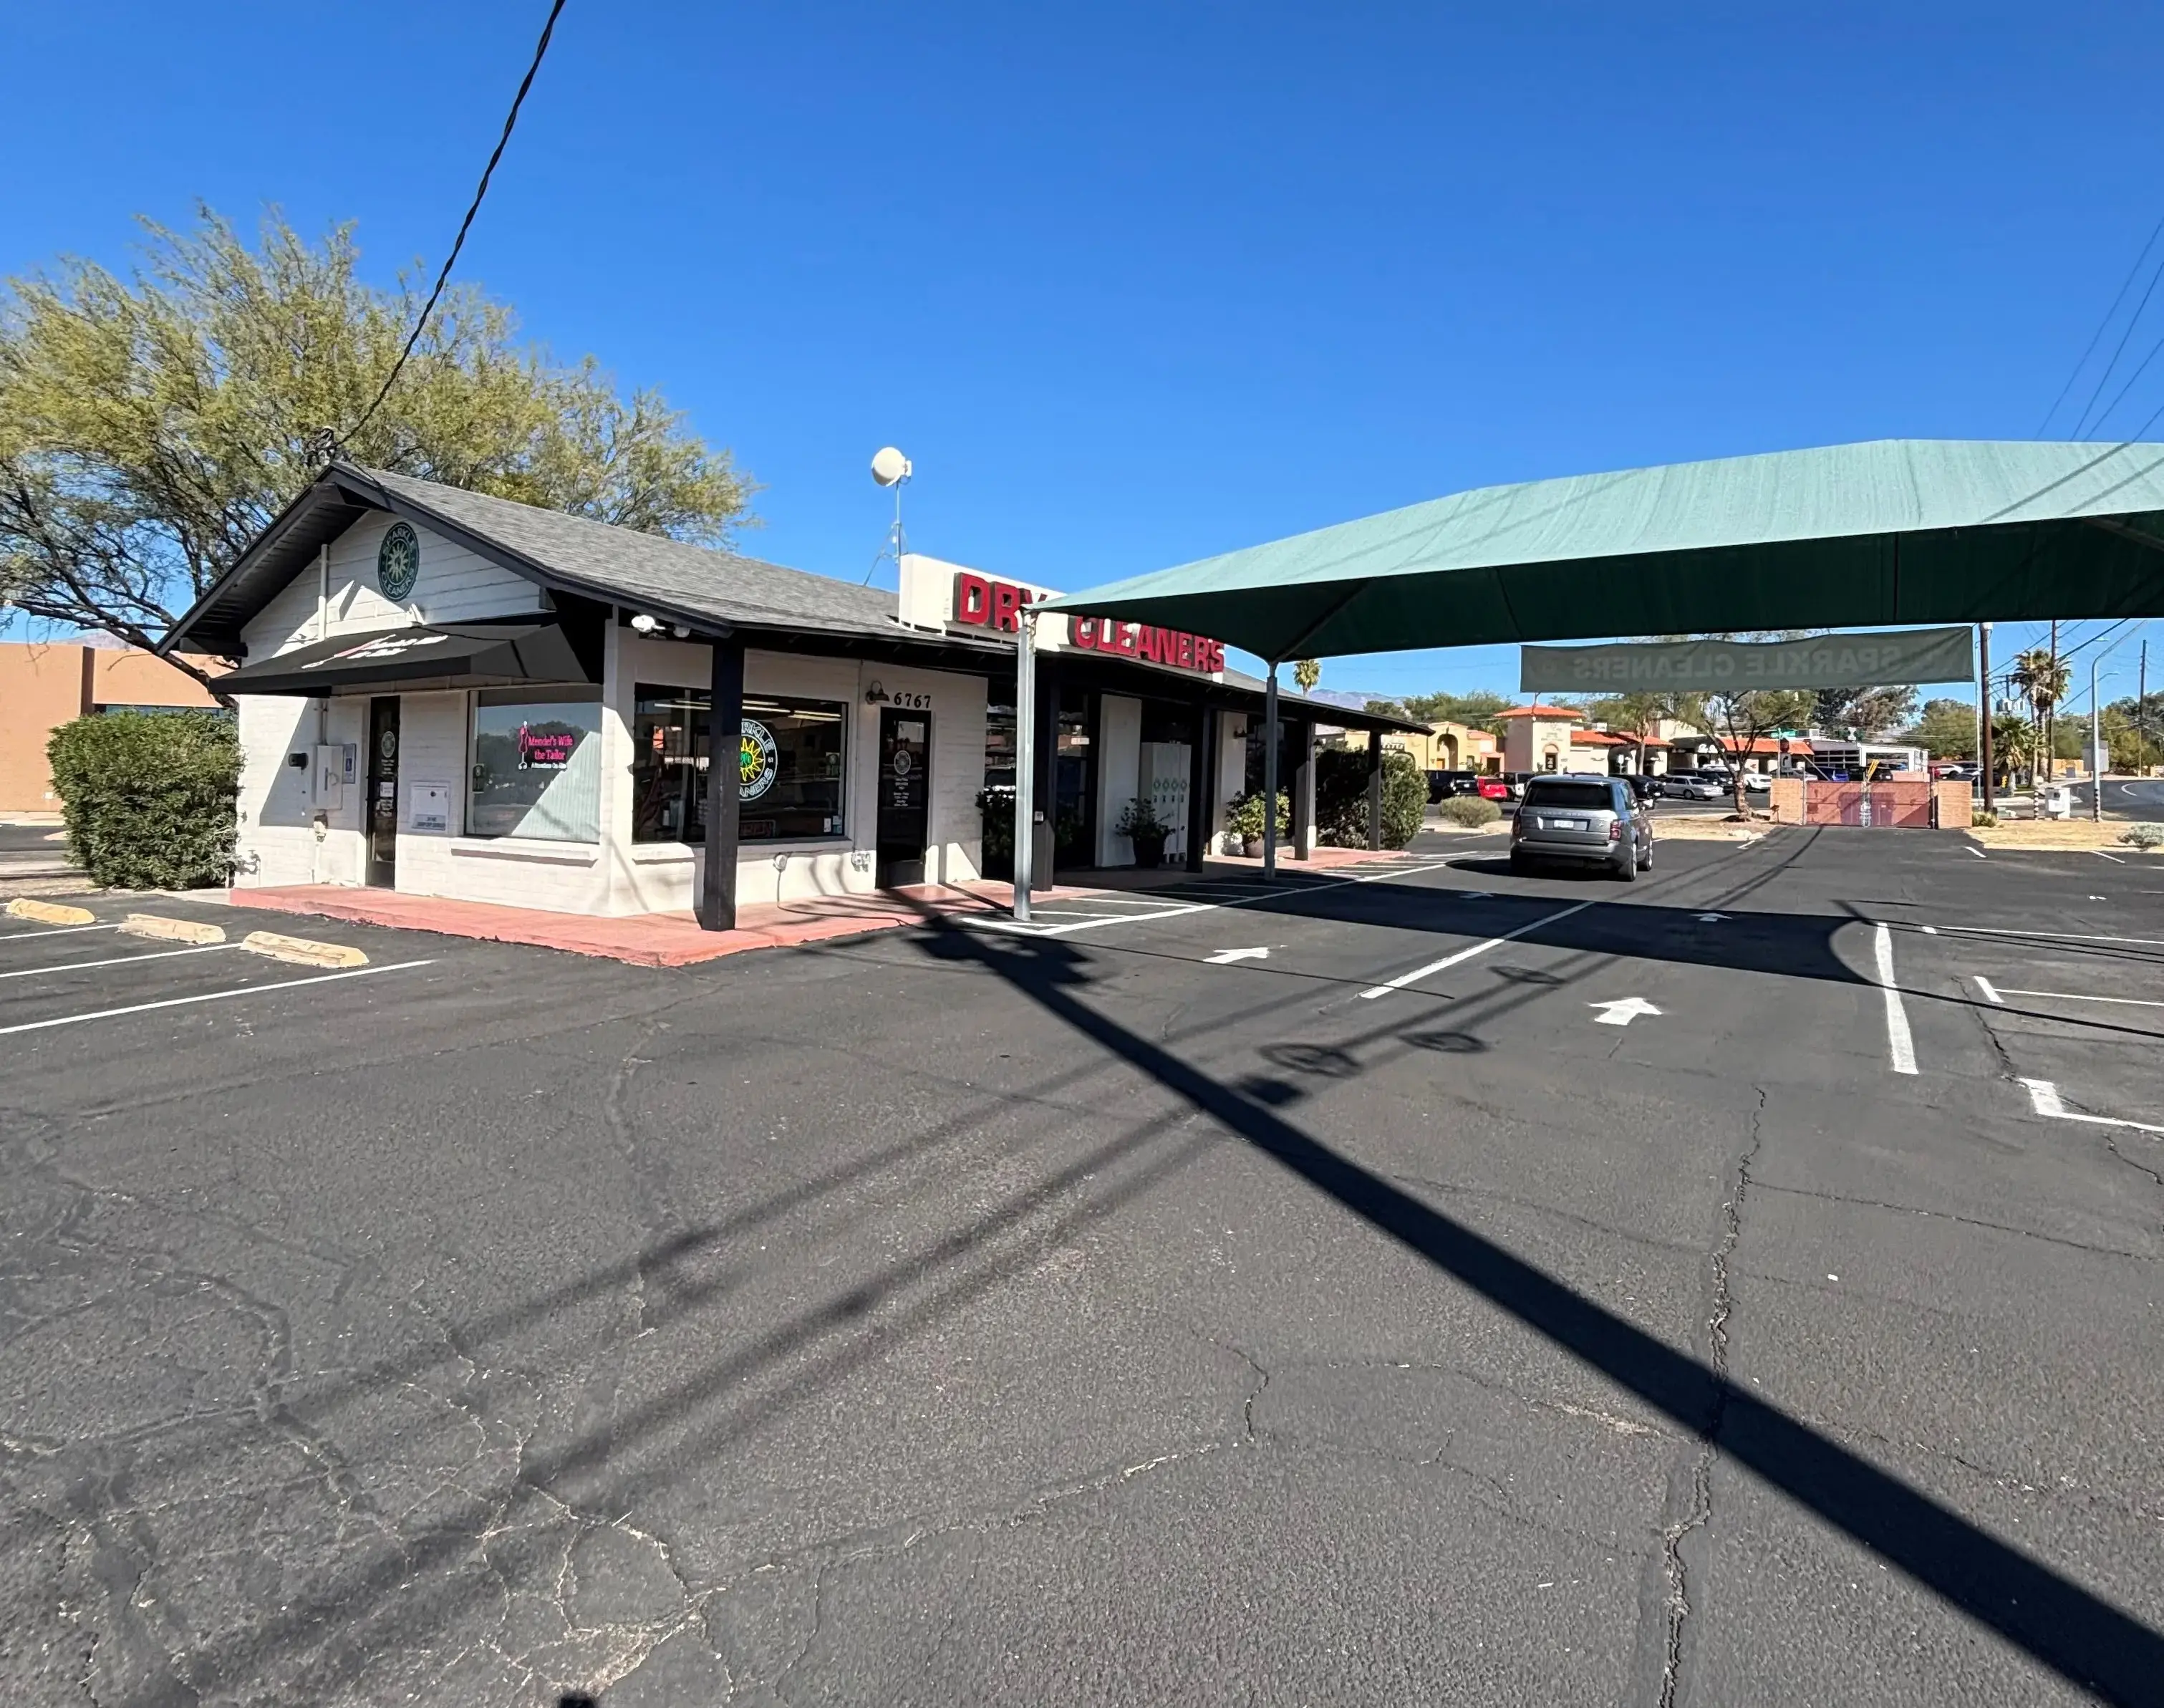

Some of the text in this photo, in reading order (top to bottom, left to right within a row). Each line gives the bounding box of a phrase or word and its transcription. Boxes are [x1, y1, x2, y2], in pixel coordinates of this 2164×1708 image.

[1071, 616, 1225, 674] CLEANERS
[894, 692, 931, 709] 6767
[558, 735, 574, 746] Wife
[534, 749, 566, 761] the Tailor
